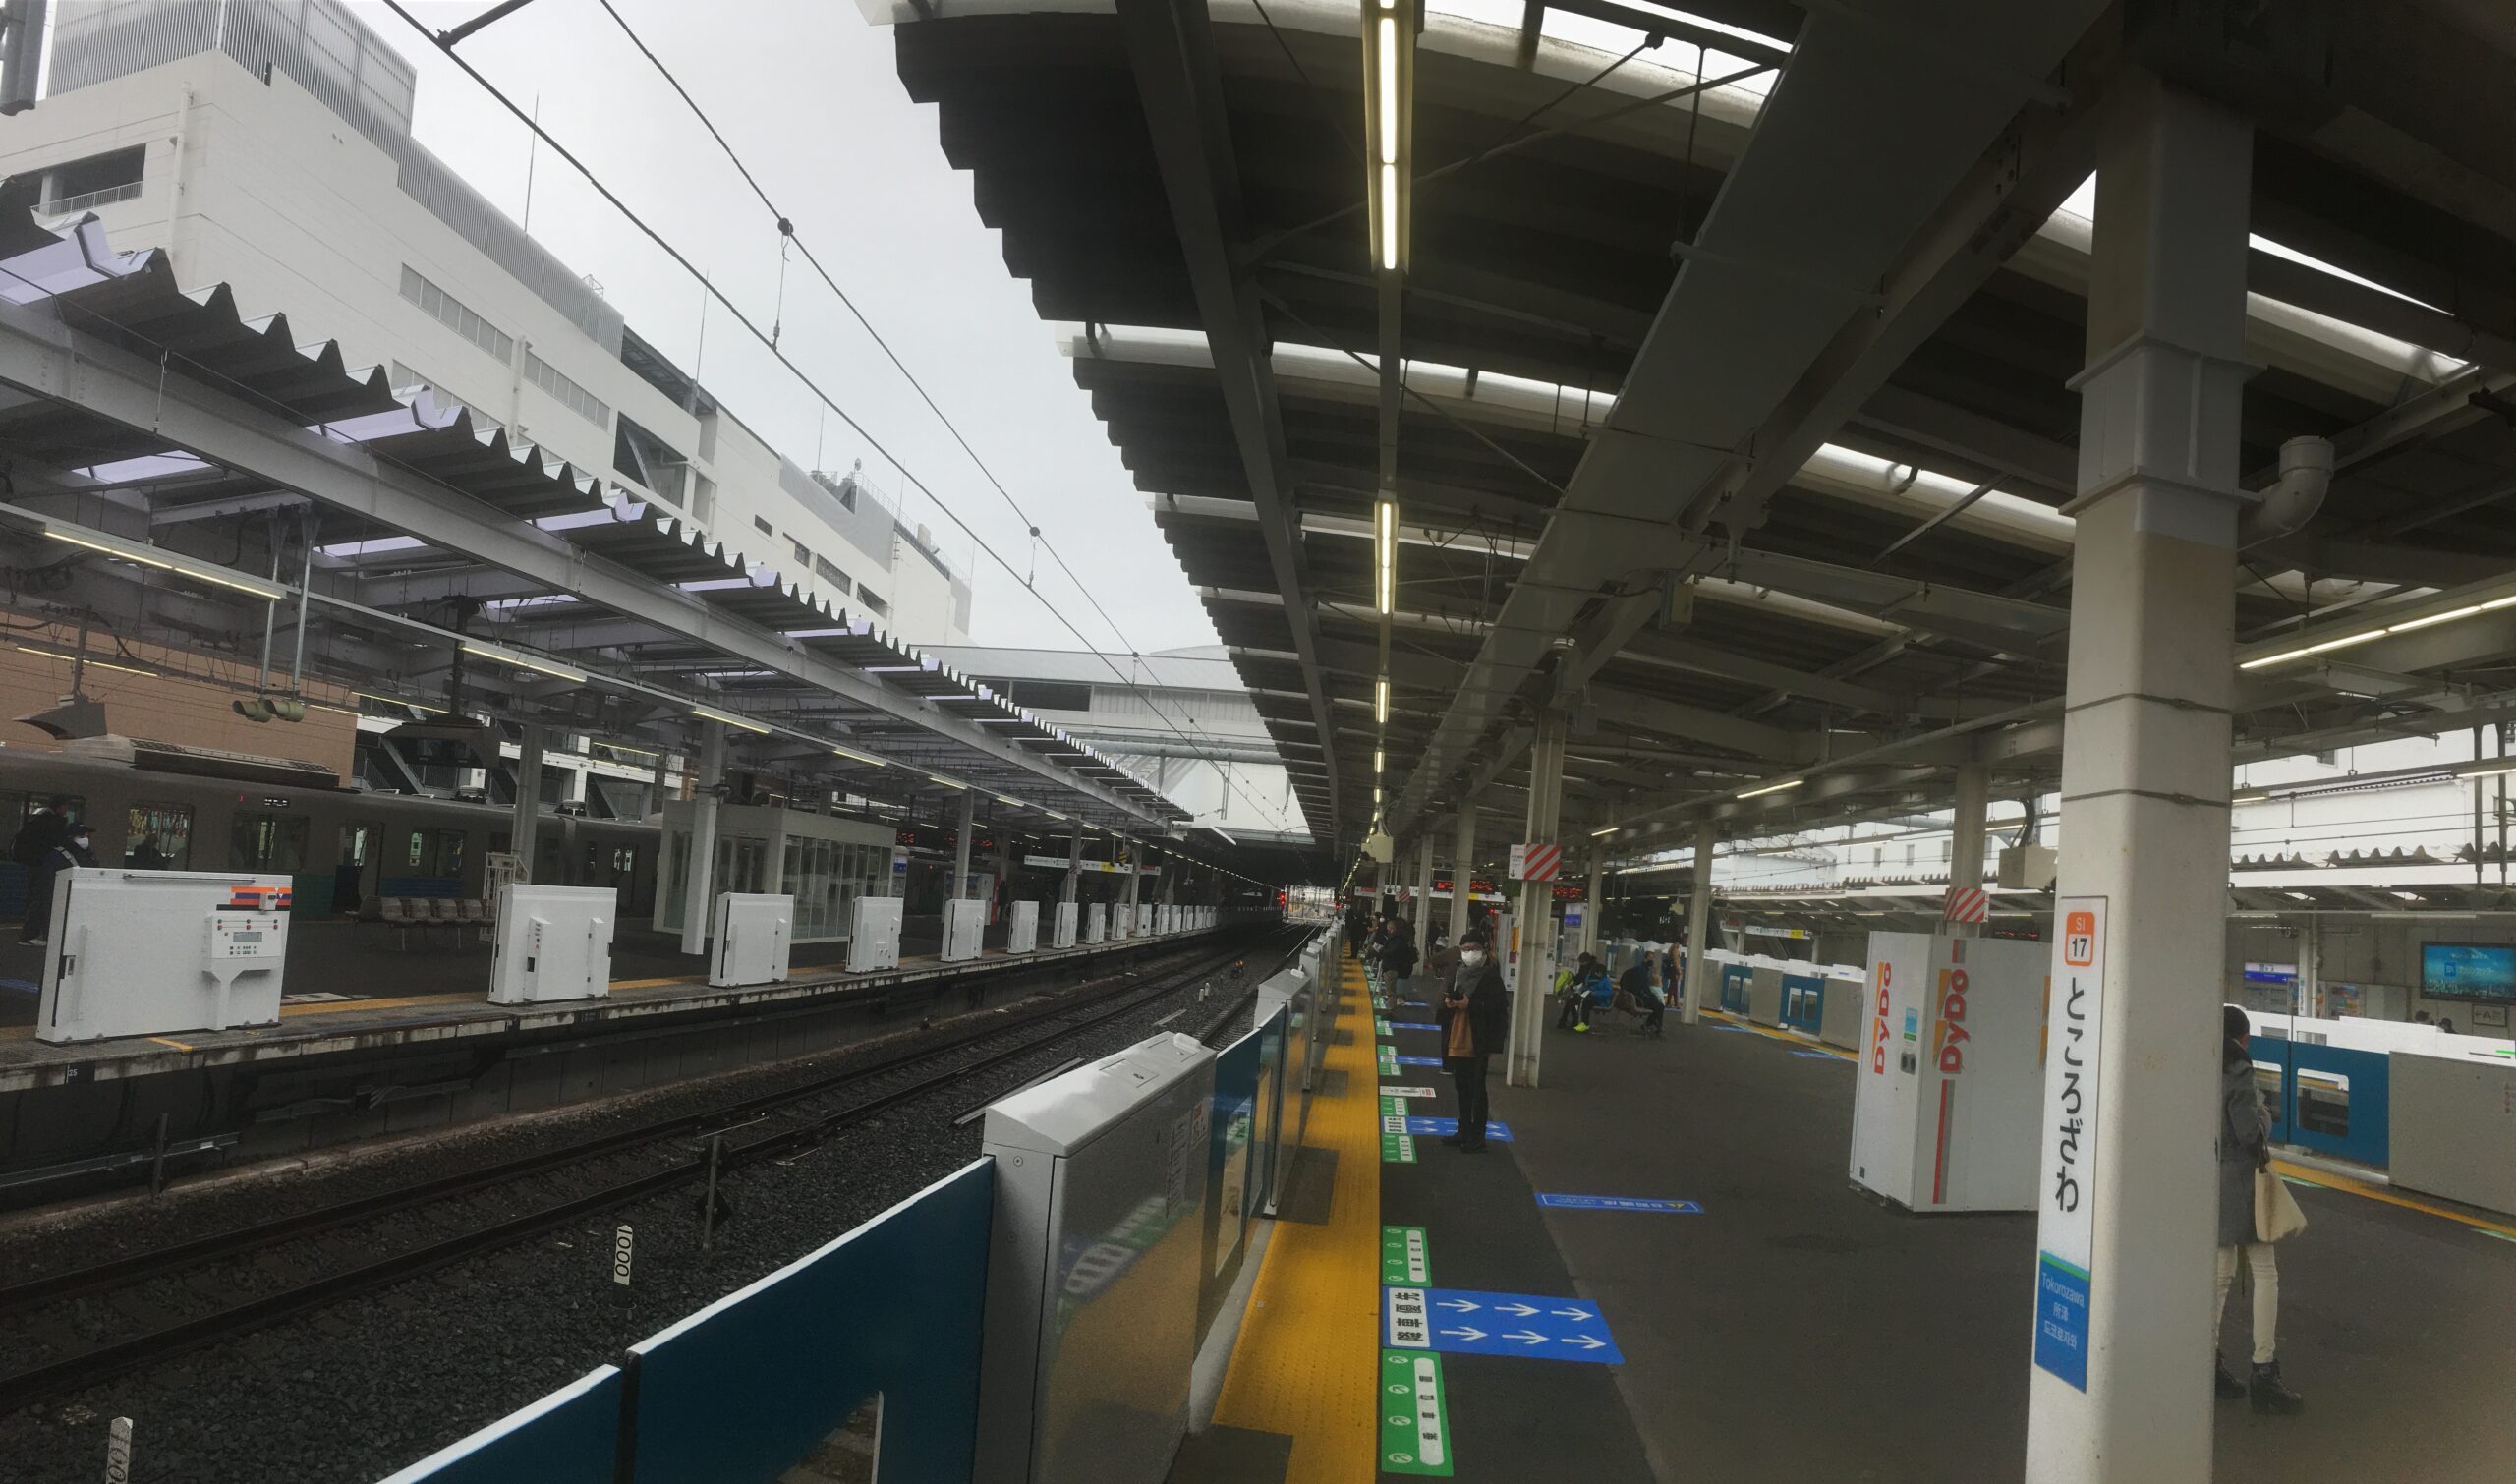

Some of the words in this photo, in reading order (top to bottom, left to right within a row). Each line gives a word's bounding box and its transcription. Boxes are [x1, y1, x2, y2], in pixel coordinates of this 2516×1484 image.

[2072, 937, 2087, 958] 17
[2076, 916, 2086, 931] SI
[1939, 969, 1971, 1075] DyDo
[2054, 976, 2086, 1214] ところざわ
[615, 1228, 633, 1277] 1000
[2041, 1272, 2085, 1309] Tokorozawa
[1394, 1291, 1423, 1342] 降車優先
